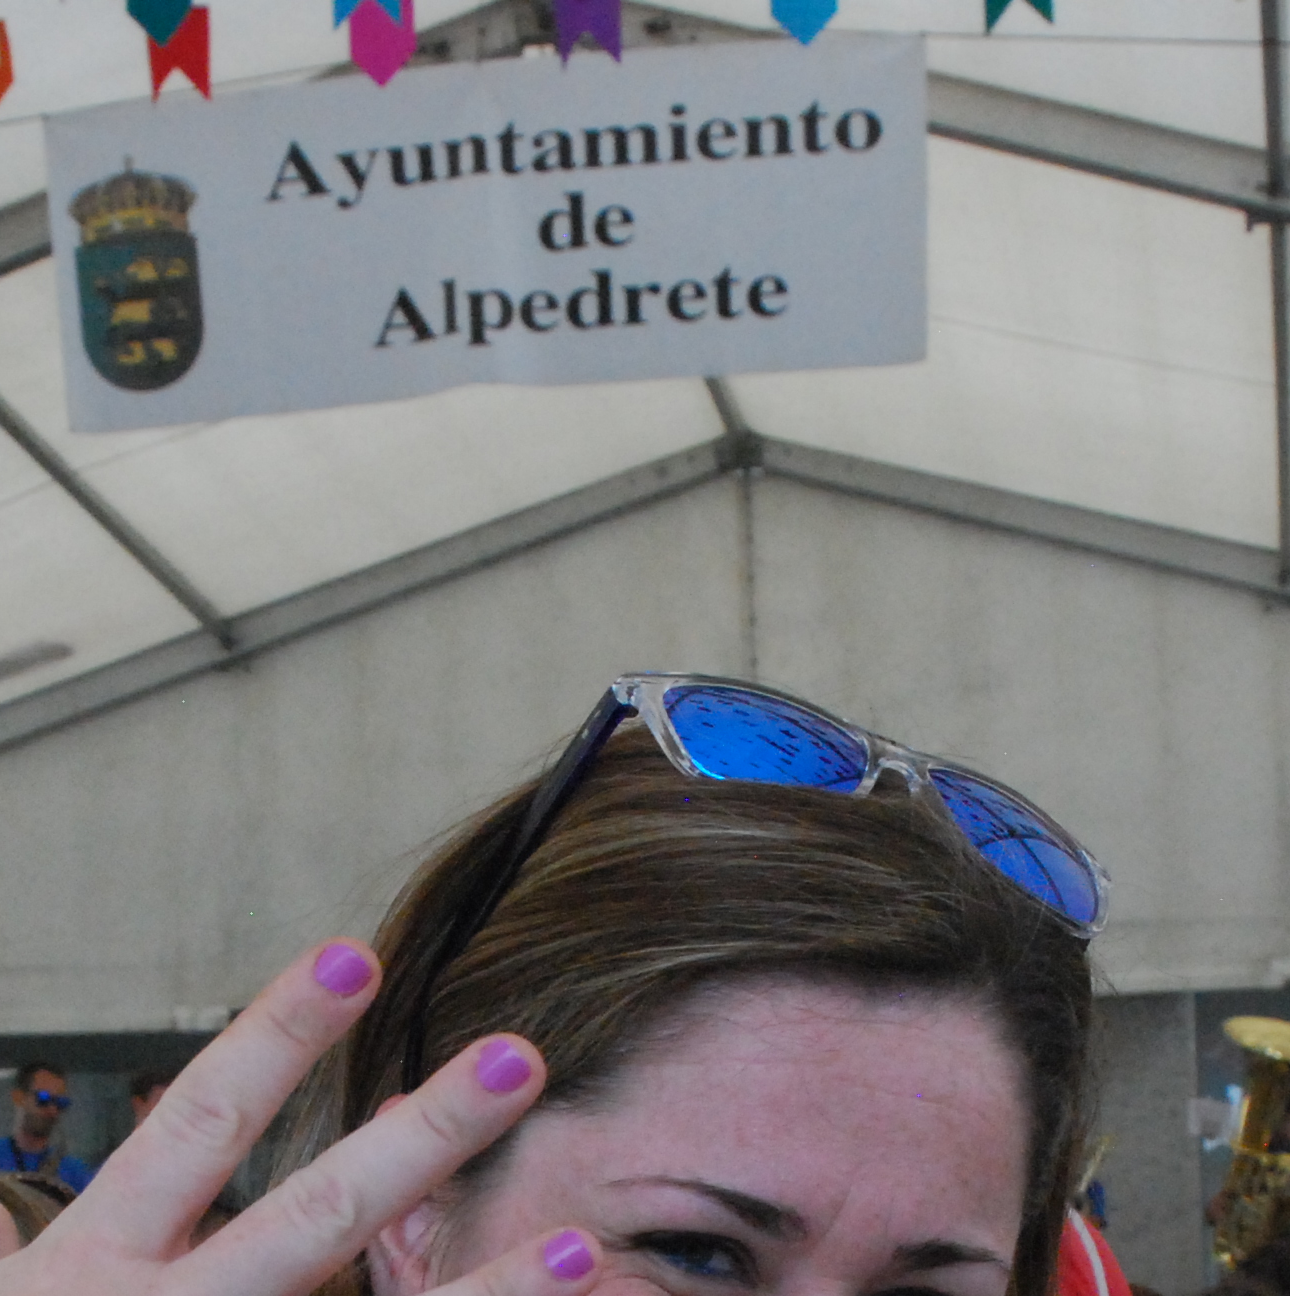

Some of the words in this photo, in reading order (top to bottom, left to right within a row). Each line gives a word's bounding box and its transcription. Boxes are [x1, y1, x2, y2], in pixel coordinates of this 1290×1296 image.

[267, 102, 884, 211] Ayuntamiento
[537, 190, 635, 253] de
[374, 267, 789, 348] Alpedrete
